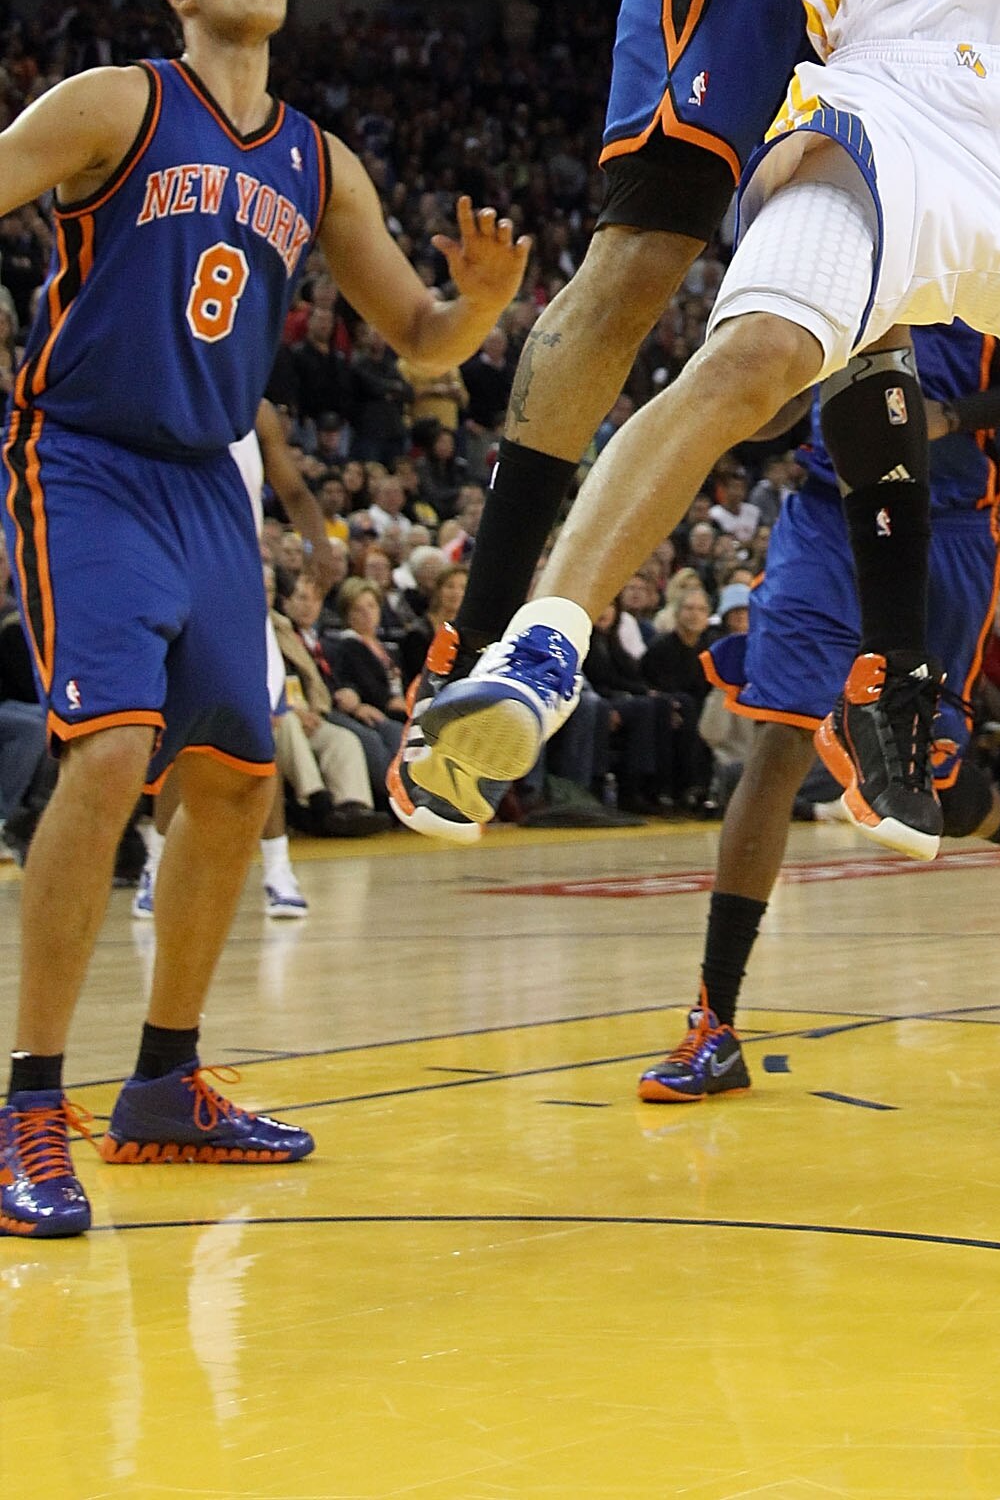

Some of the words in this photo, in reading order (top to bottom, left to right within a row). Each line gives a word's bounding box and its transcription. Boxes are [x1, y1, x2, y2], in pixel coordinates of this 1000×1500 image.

[136, 163, 230, 226] NEW
[235, 172, 312, 279] YORK
[186, 241, 250, 344] 8
